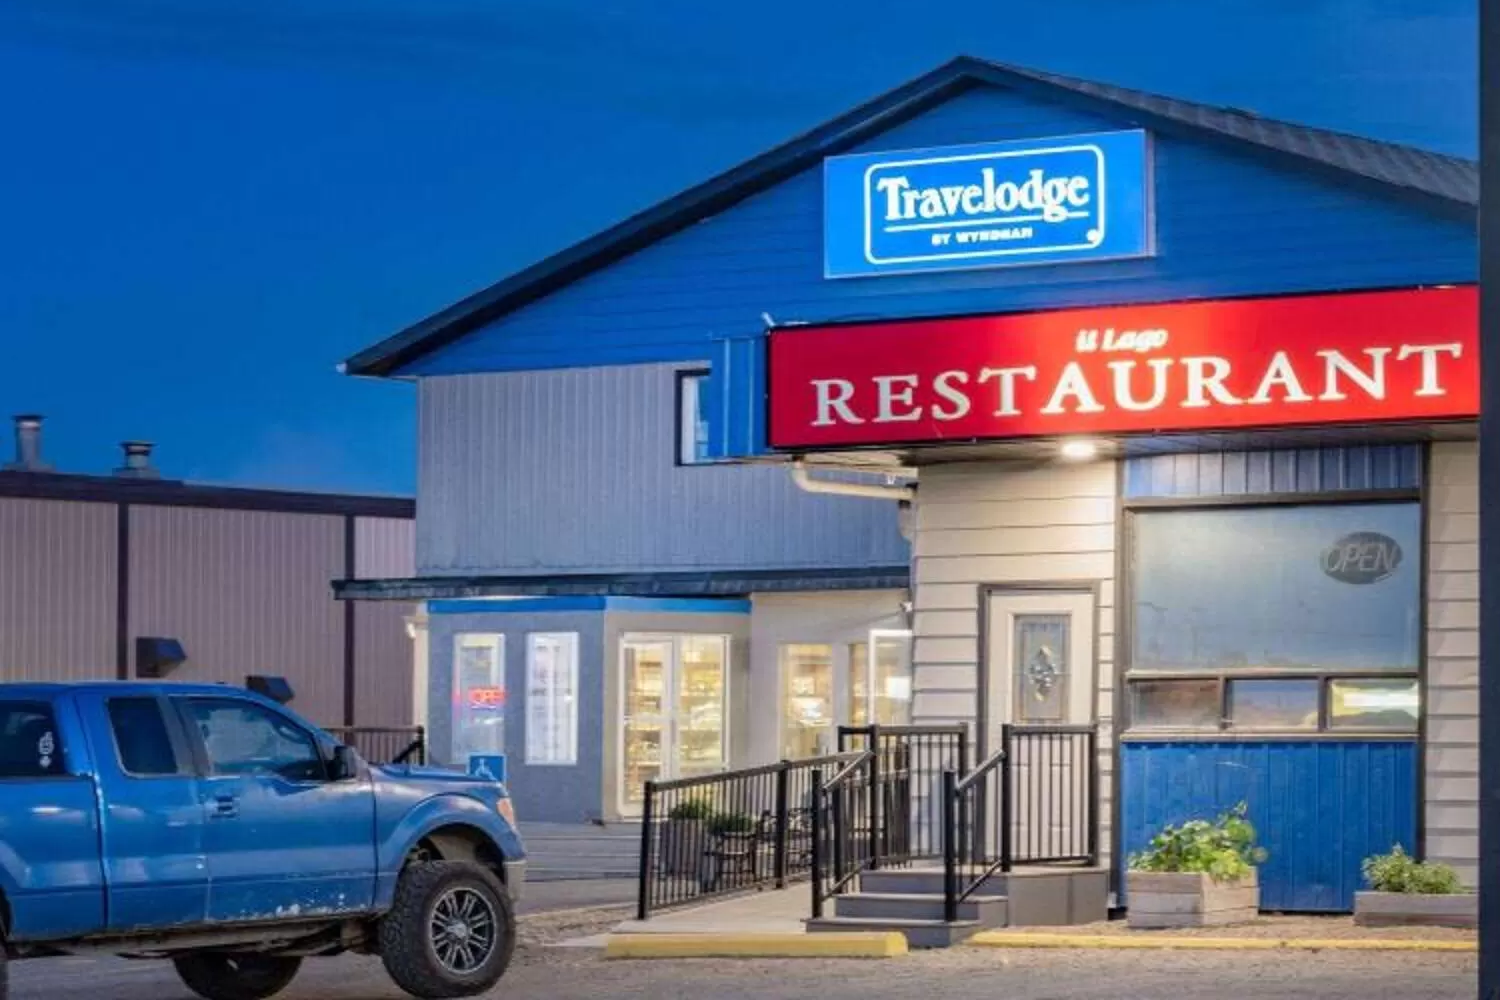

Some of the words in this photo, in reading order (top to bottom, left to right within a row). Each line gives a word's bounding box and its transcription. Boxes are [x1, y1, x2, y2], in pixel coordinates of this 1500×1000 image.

[877, 167, 1090, 223] Travelodge
[811, 342, 1463, 427] RESTAURANT
[1320, 543, 1398, 573] OPEN
